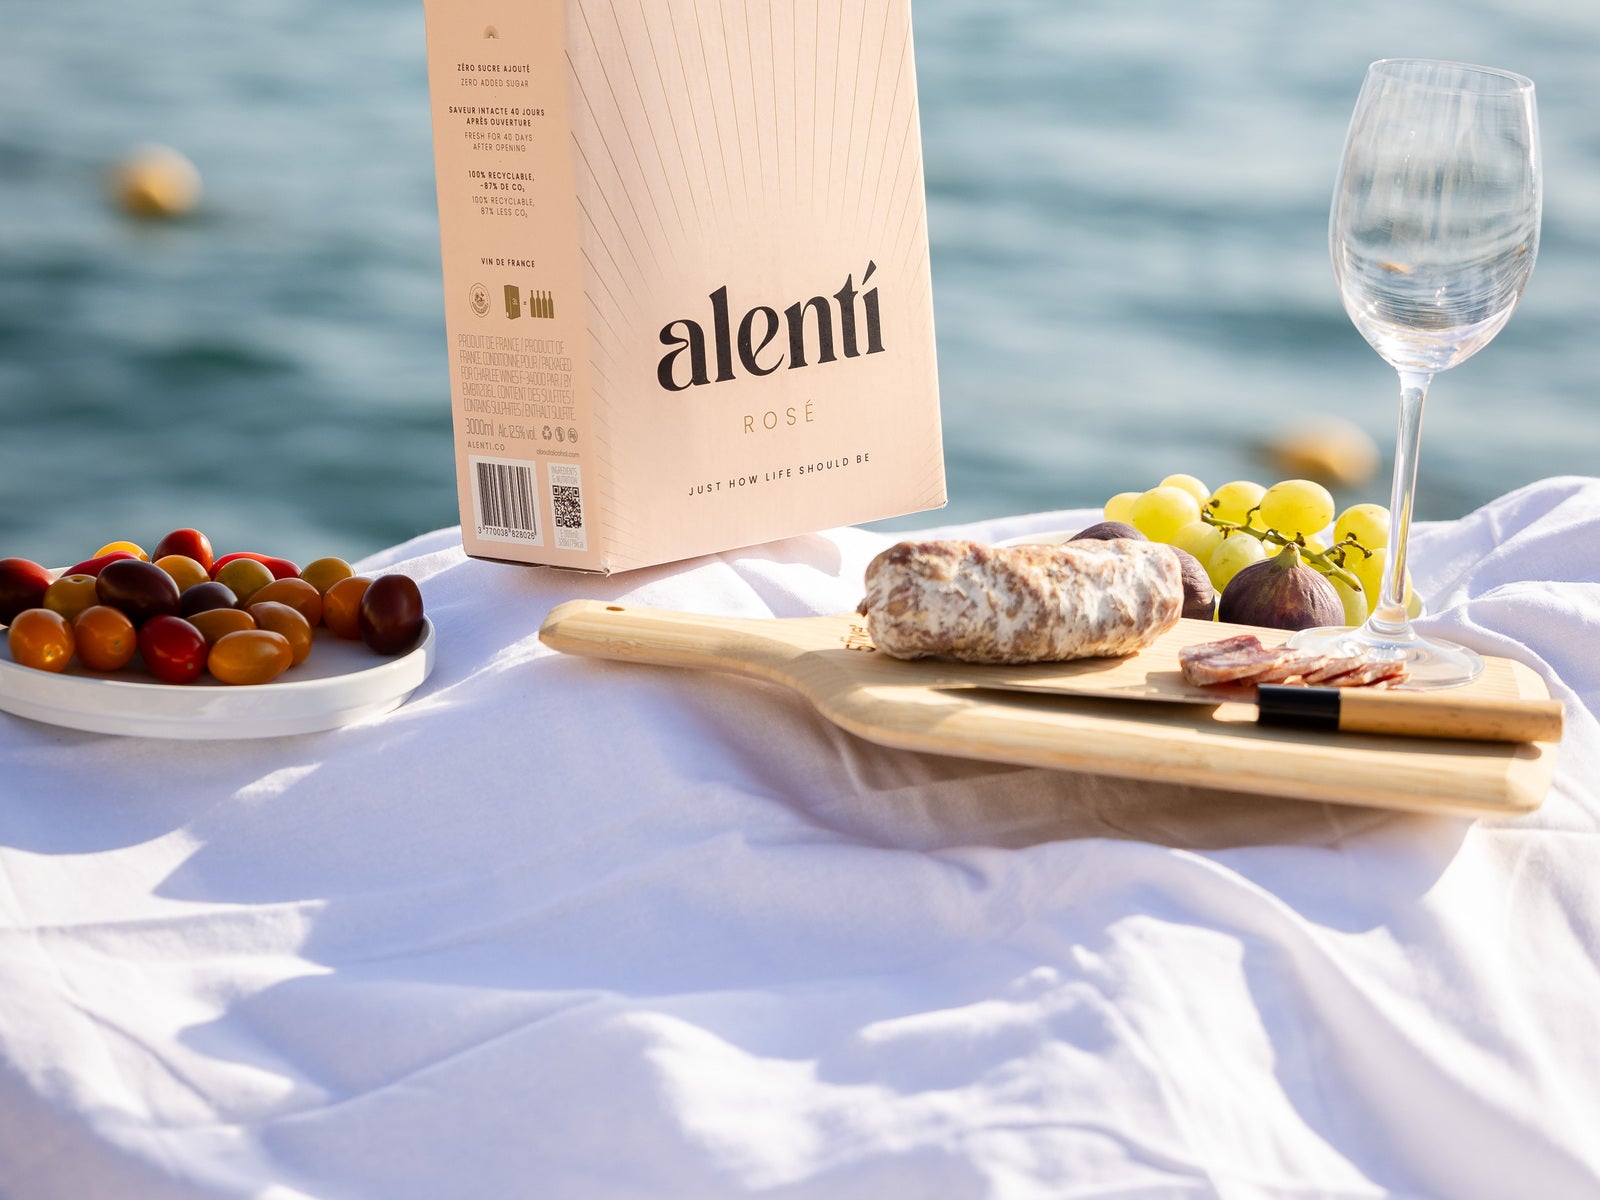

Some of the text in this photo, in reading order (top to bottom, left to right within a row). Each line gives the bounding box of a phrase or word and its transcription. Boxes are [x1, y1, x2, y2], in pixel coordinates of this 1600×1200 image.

[457, 62, 530, 73] ZÉRO SUCRE AJOUTÉ
[461, 78, 529, 88] ZERO ADDED SUGAR
[449, 106, 545, 117] SAVEUR INTACTE 40 JOURS
[466, 116, 531, 127] APRÈS OUVERTURE
[464, 131, 533, 142] FRESH FOR 40 DAYS
[473, 143, 526, 152] AFTER OPENING
[468, 170, 535, 182] 100% RECYCLABLE,
[500, 183, 509, 191] DE
[472, 195, 535, 207] 100% RECYCLABLE,
[480, 207, 494, 215] 87%
[497, 208, 512, 216] LESS
[481, 257, 535, 268] VIN DE FRANCE
[458, 334, 484, 350] PRODUIT
[486, 335, 495, 350] DE
[496, 336, 520, 352] FRANCE
[525, 338, 554, 354] PRODUCT
[555, 340, 565, 355] OF
[521, 354, 538, 370] POUR
[542, 356, 572, 371] PACKAGED
[461, 365, 474, 380] FOR
[500, 369, 520, 384] WINES
[546, 373, 560, 387] PAR
[564, 374, 572, 388] BY
[497, 385, 527, 401] CONTIENT
[528, 387, 540, 402] DES
[541, 388, 571, 404] SULFITES
[464, 398, 491, 414] CONTAINS
[491, 400, 521, 417] SULPHITES
[743, 399, 815, 434] ROSÉ
[465, 417, 495, 437] 3000ml
[467, 441, 505, 452] ALENTI.CO
[688, 453, 870, 496] JUST HOW LIFE SHOULD BE
